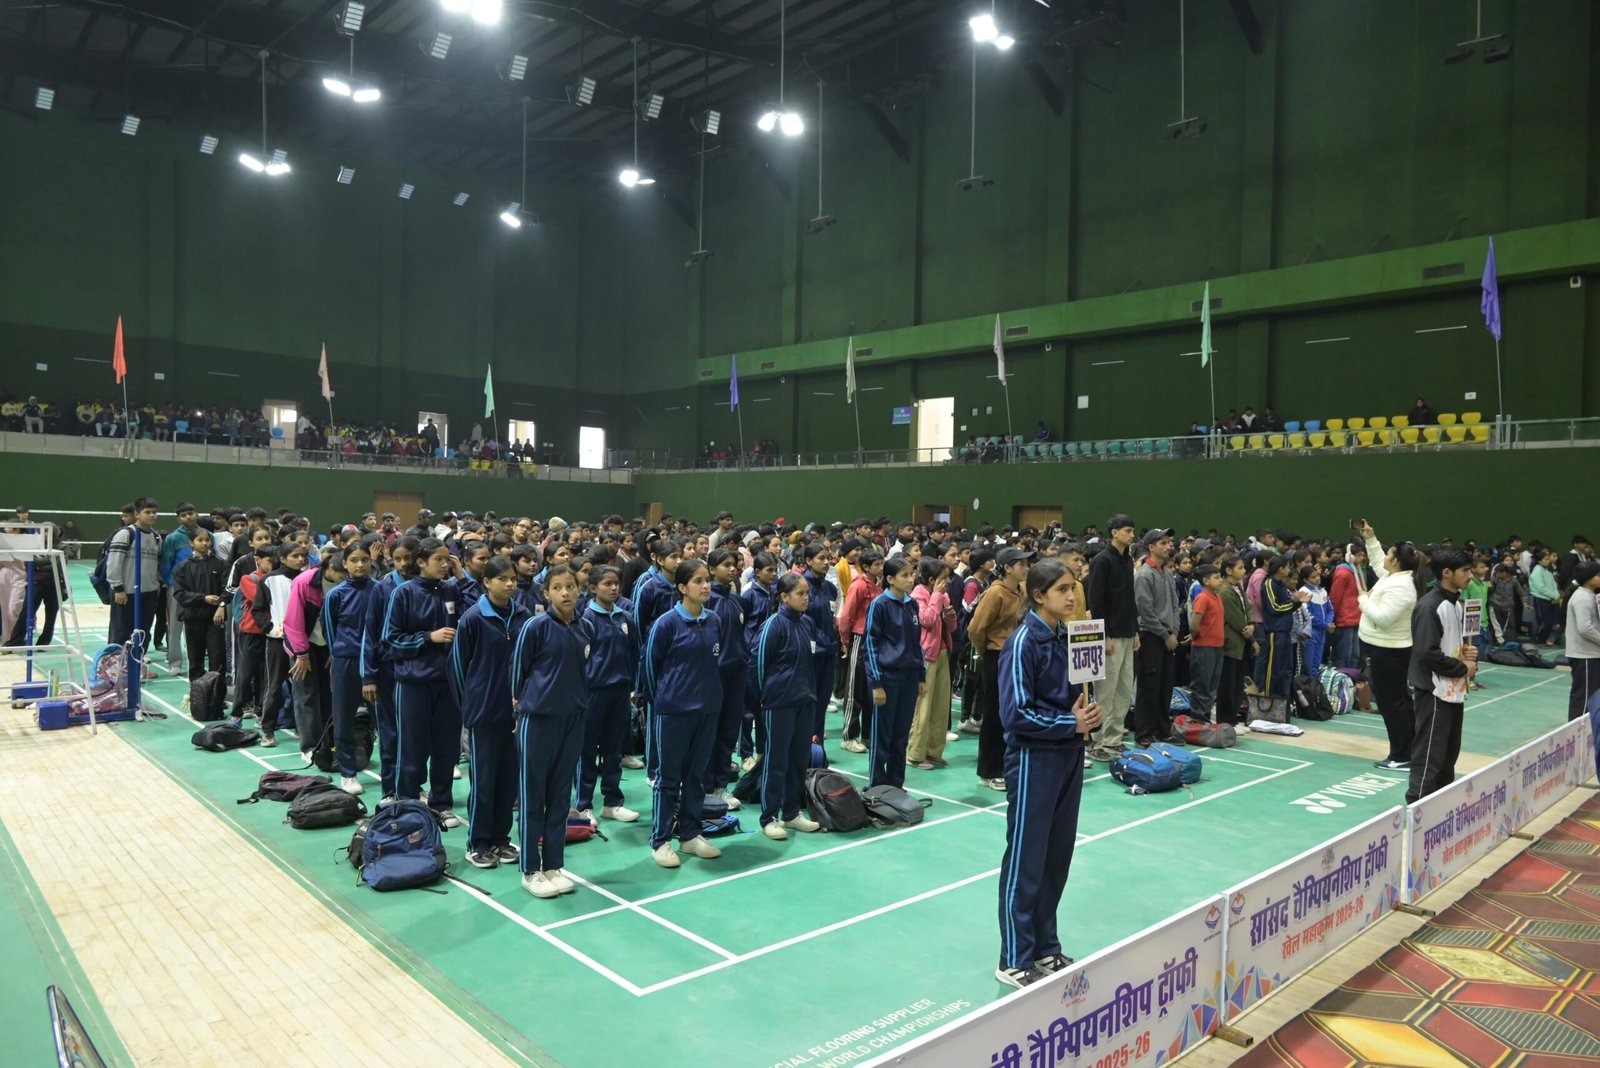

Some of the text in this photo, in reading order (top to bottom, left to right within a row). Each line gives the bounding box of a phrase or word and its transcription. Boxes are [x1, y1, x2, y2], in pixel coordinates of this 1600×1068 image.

[1072, 645, 1103, 676] राजपुर
[1319, 773, 1406, 799] YONEX
[1250, 835, 1389, 947] सांसद चैम्पियनशिप ट्रॉफी
[1282, 934, 1301, 960] खेल
[1335, 894, 1364, 928] 2025-26
[1158, 946, 1198, 1019] ट्रॉफी
[808, 1024, 877, 1057] FLOORING
[873, 998, 936, 1030] SUPPLIER
[817, 998, 971, 1068] WORLD CHAMPIONSHIPS
